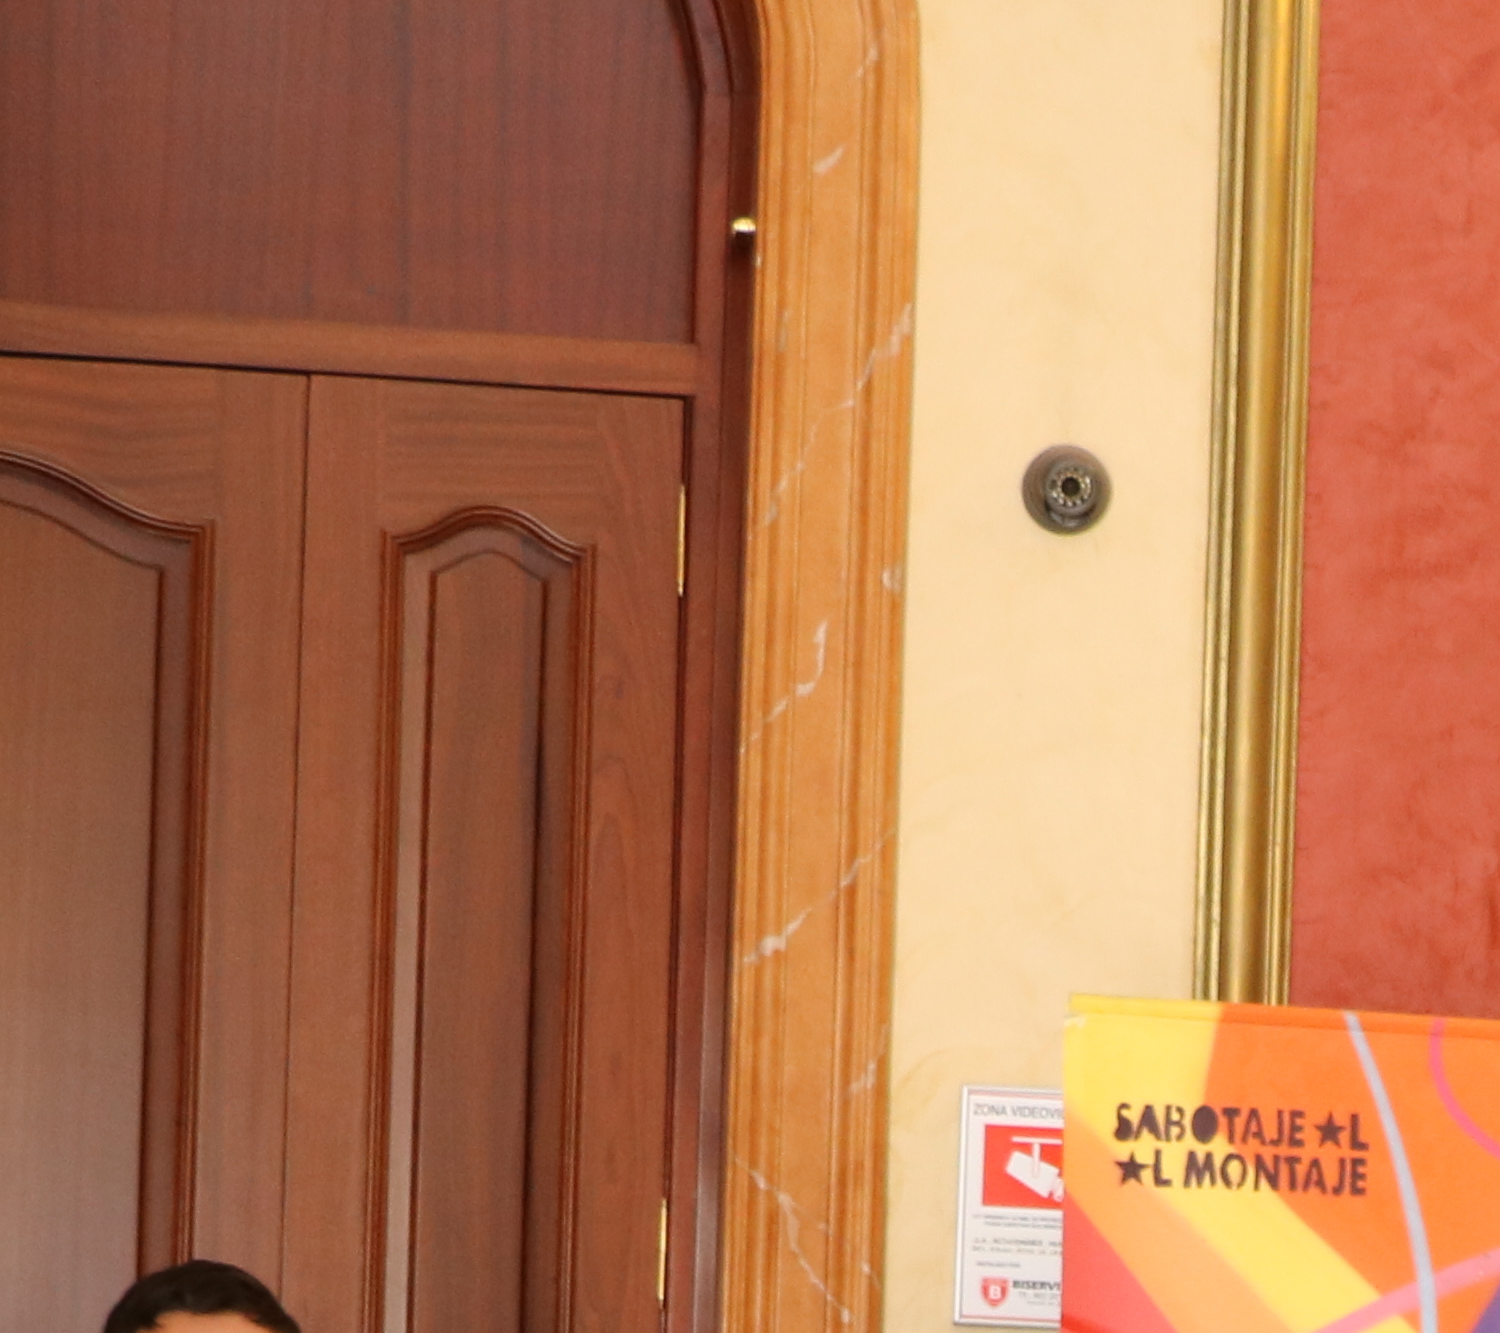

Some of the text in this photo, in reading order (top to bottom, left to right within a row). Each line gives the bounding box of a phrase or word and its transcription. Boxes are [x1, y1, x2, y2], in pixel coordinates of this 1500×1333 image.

[973, 1102, 1064, 1120] ZONA VIDEOVI
[1114, 1102, 1306, 1147] SABOTAJE
[1183, 1149, 1368, 1196] MONTAJE
